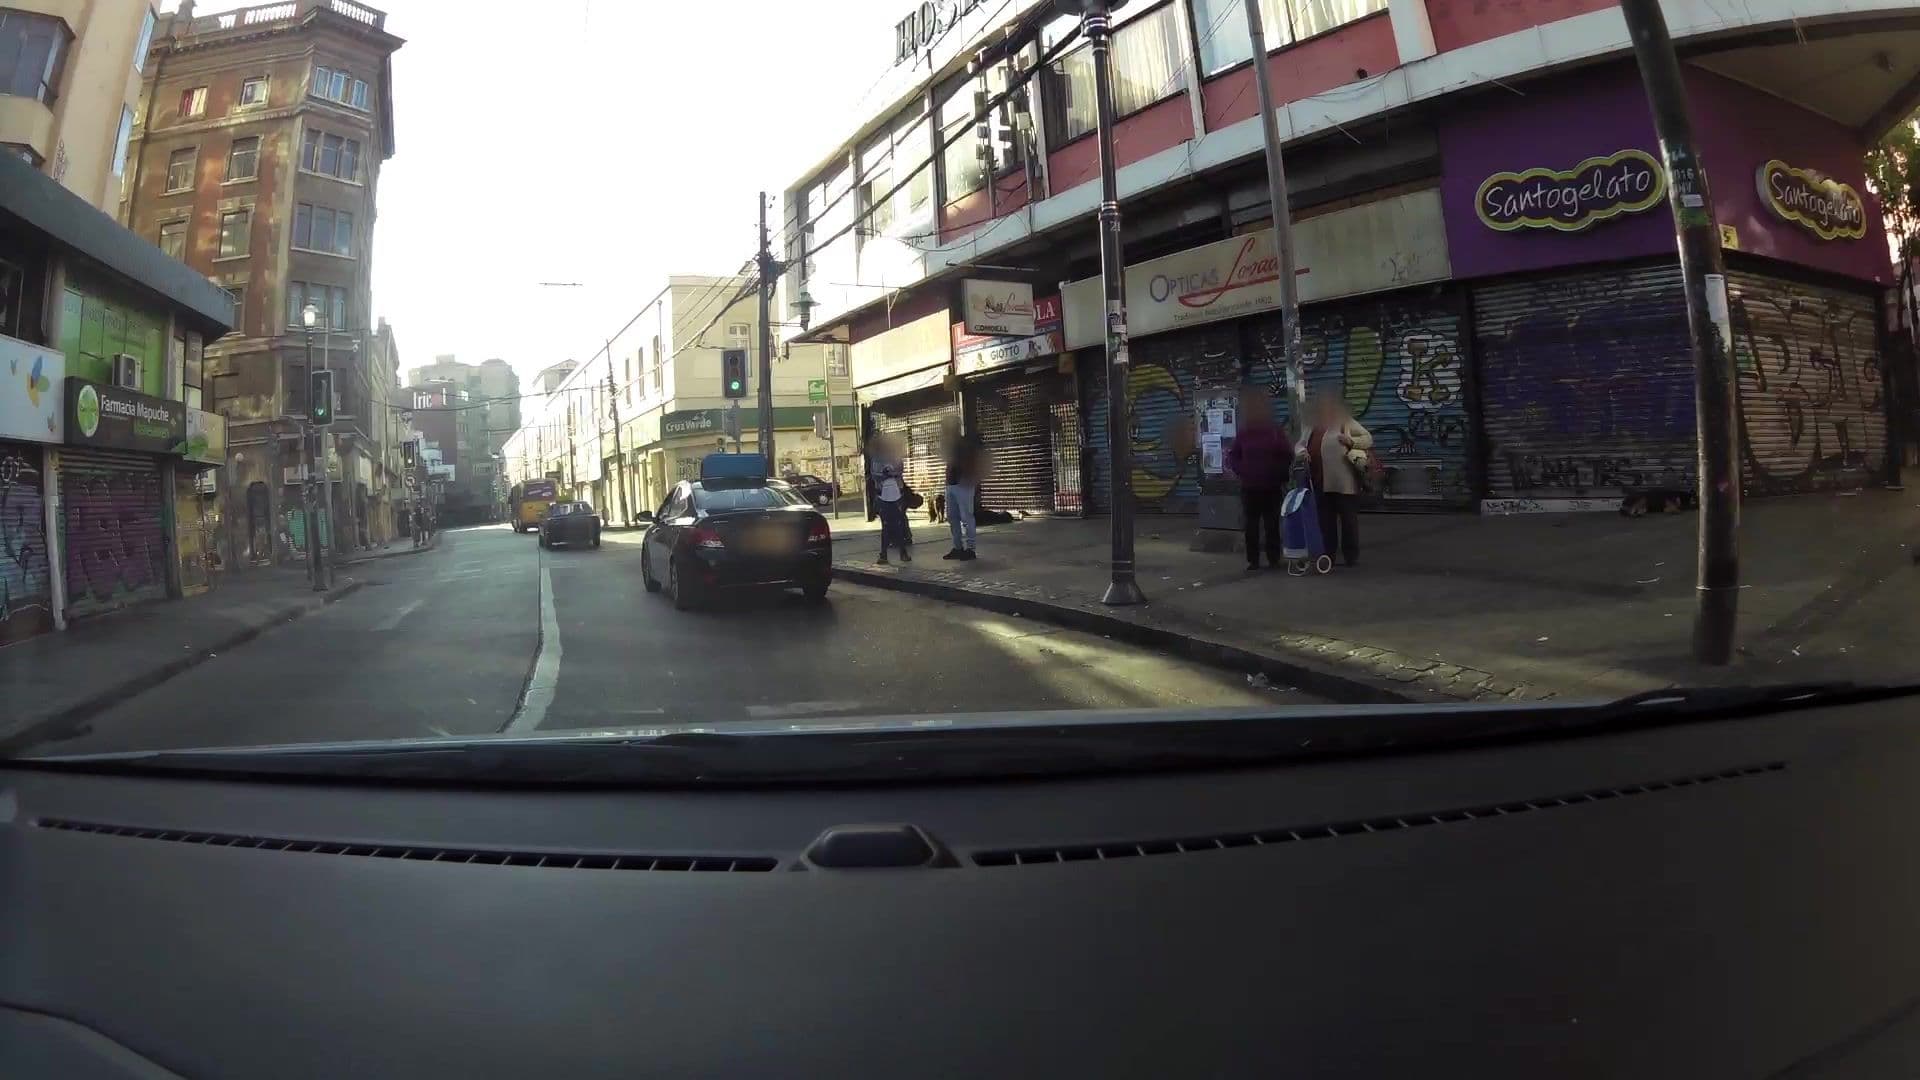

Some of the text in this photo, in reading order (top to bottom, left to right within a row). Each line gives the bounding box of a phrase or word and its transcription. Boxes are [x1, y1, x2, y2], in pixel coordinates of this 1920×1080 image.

[1486, 165, 1650, 218] Santogelato
[1771, 171, 1861, 226] Santogelato
[990, 343, 1020, 361] GIOTTO
[101, 395, 169, 423] Farmacia Mapuche
[665, 422, 686, 433] Cruz
